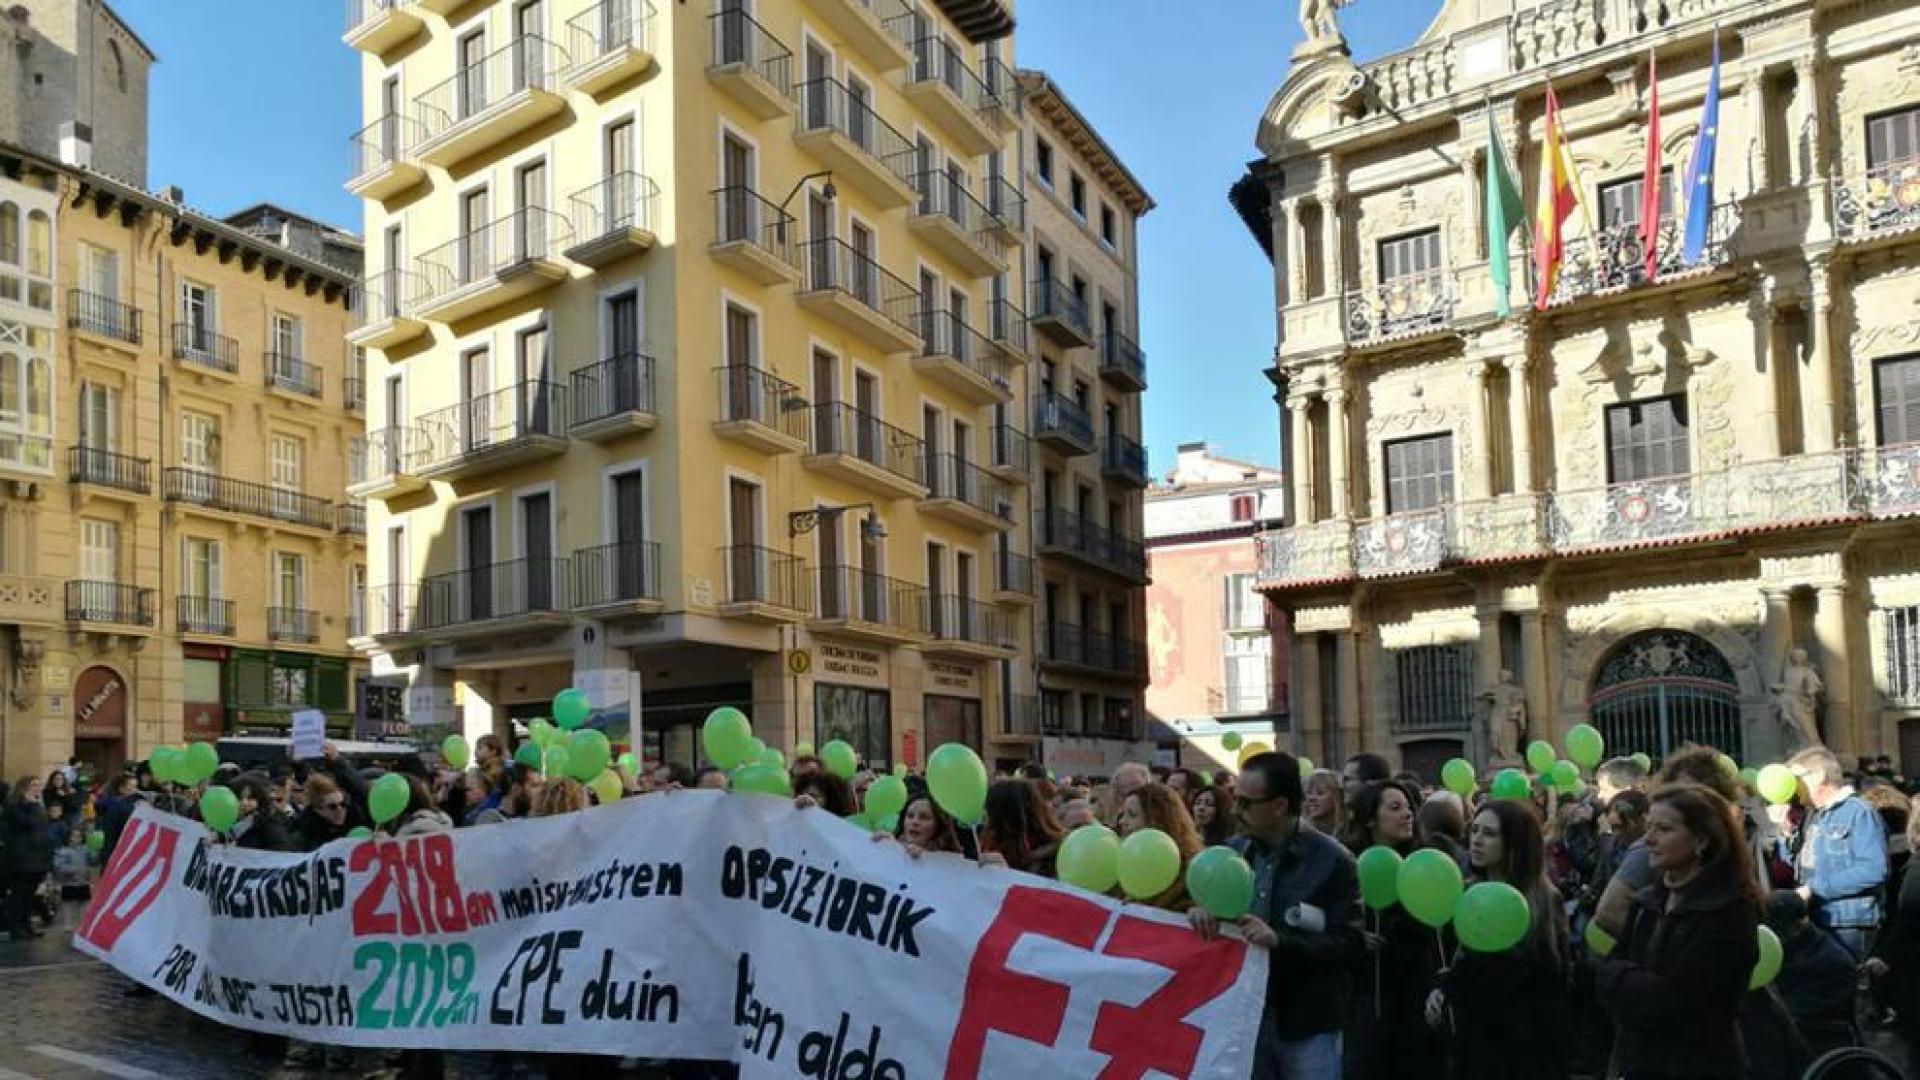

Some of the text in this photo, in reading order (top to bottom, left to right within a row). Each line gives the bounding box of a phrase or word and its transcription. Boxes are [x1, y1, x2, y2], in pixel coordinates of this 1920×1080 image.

[269, 982, 354, 1026] JUSTA
[490, 930, 583, 1025] EPE
[580, 948, 679, 1024] duin
